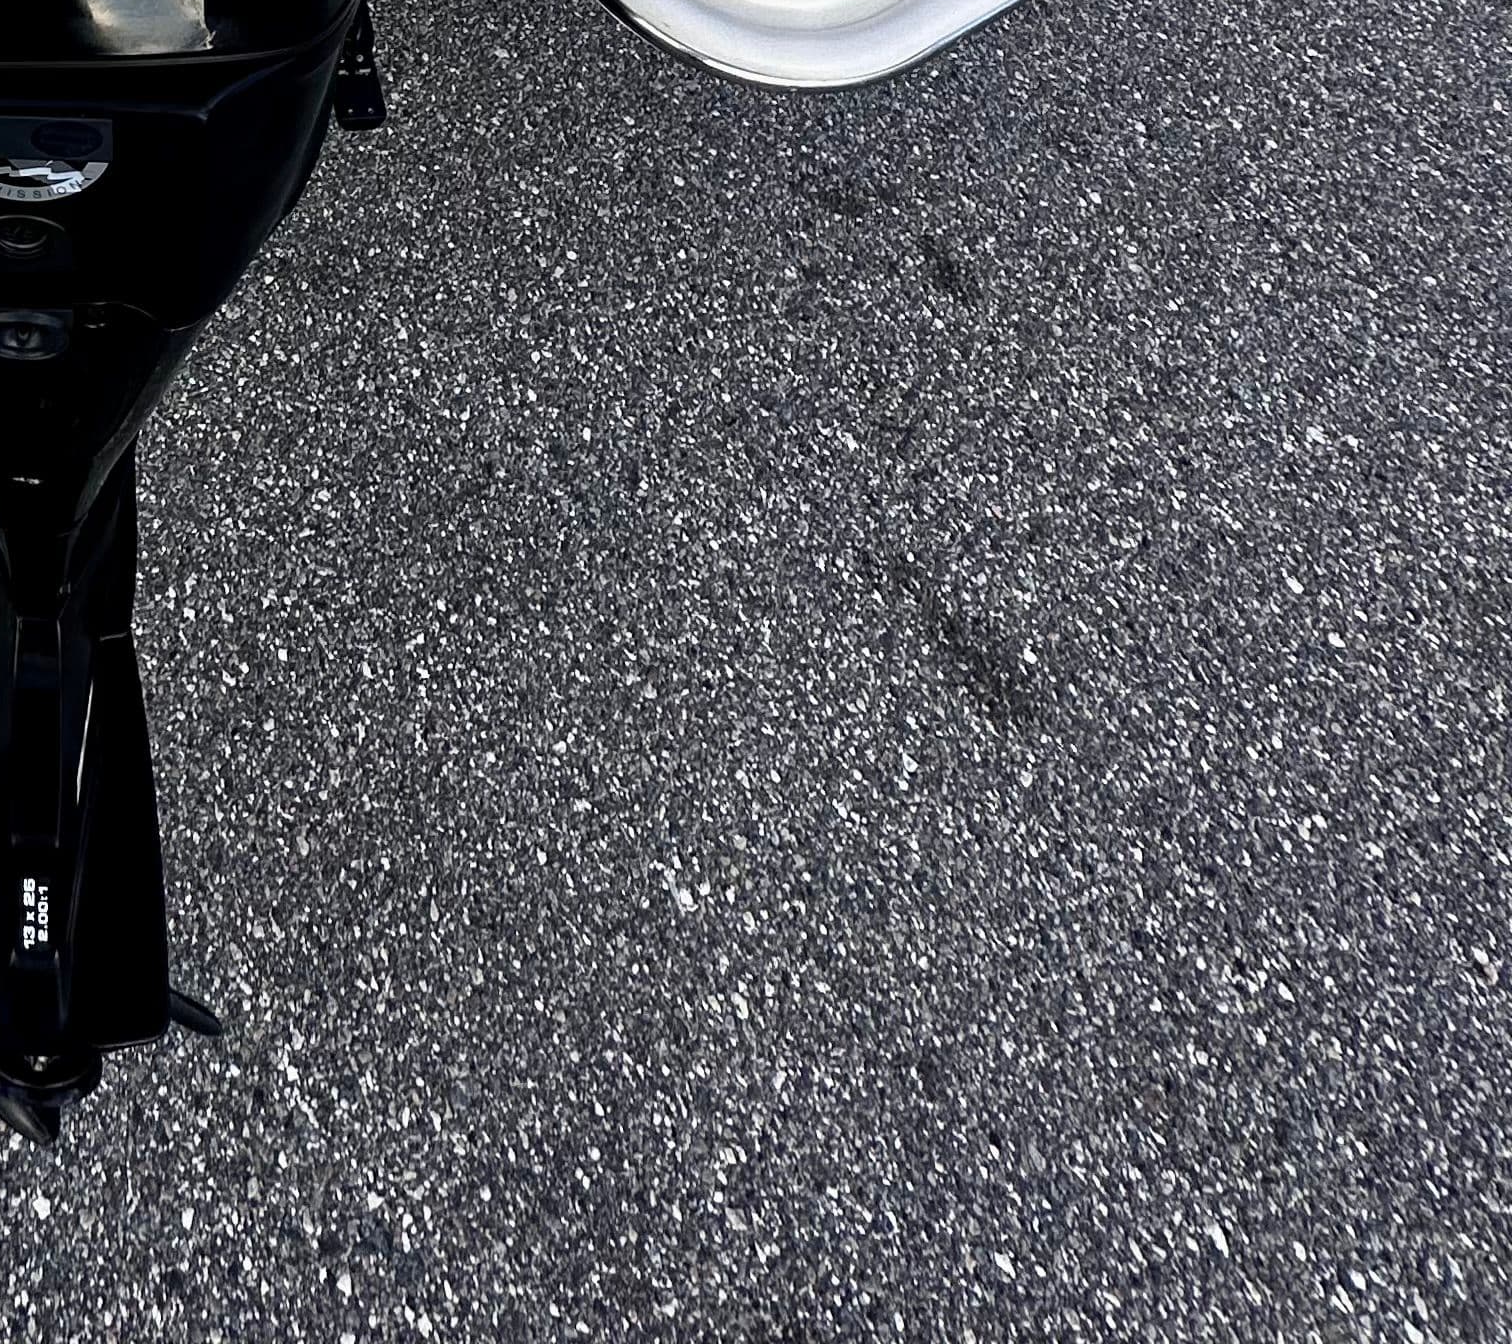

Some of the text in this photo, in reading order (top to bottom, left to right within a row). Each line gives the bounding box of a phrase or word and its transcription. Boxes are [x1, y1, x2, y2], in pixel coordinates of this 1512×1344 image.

[23, 878, 36, 906] 26
[37, 885, 49, 942] 2.00:1
[23, 924, 35, 950] 13
